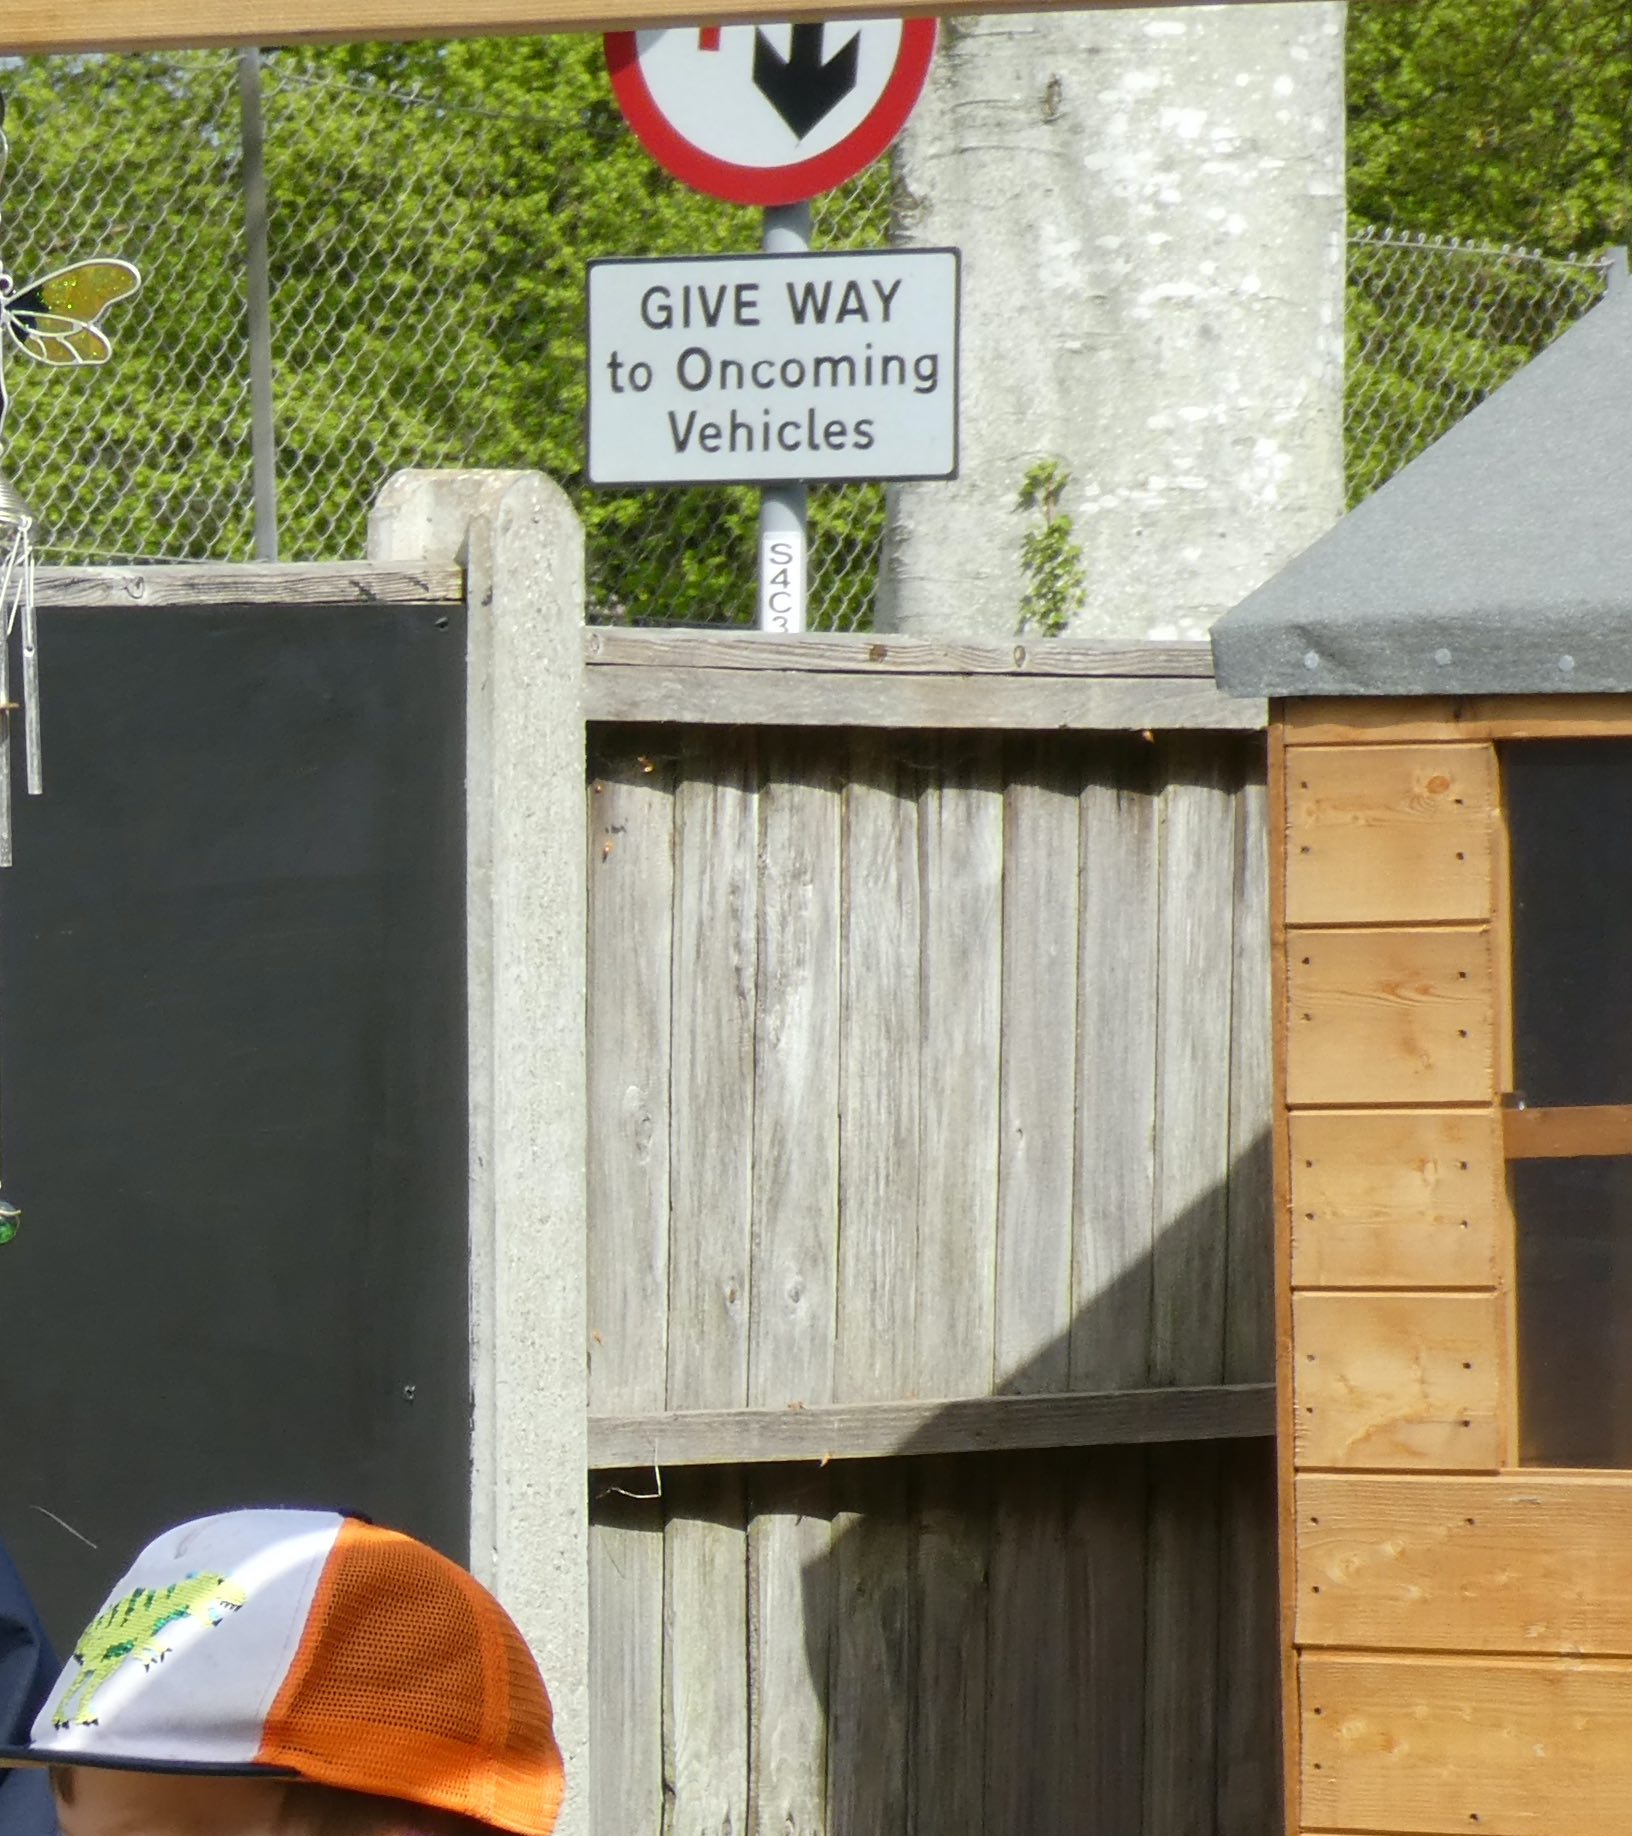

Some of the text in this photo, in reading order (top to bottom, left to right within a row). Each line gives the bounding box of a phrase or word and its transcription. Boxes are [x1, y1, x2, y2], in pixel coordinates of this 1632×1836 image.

[640, 278, 902, 330] GIVE WAY
[606, 343, 940, 395] to Oncoming
[667, 407, 875, 455] Vehicles
